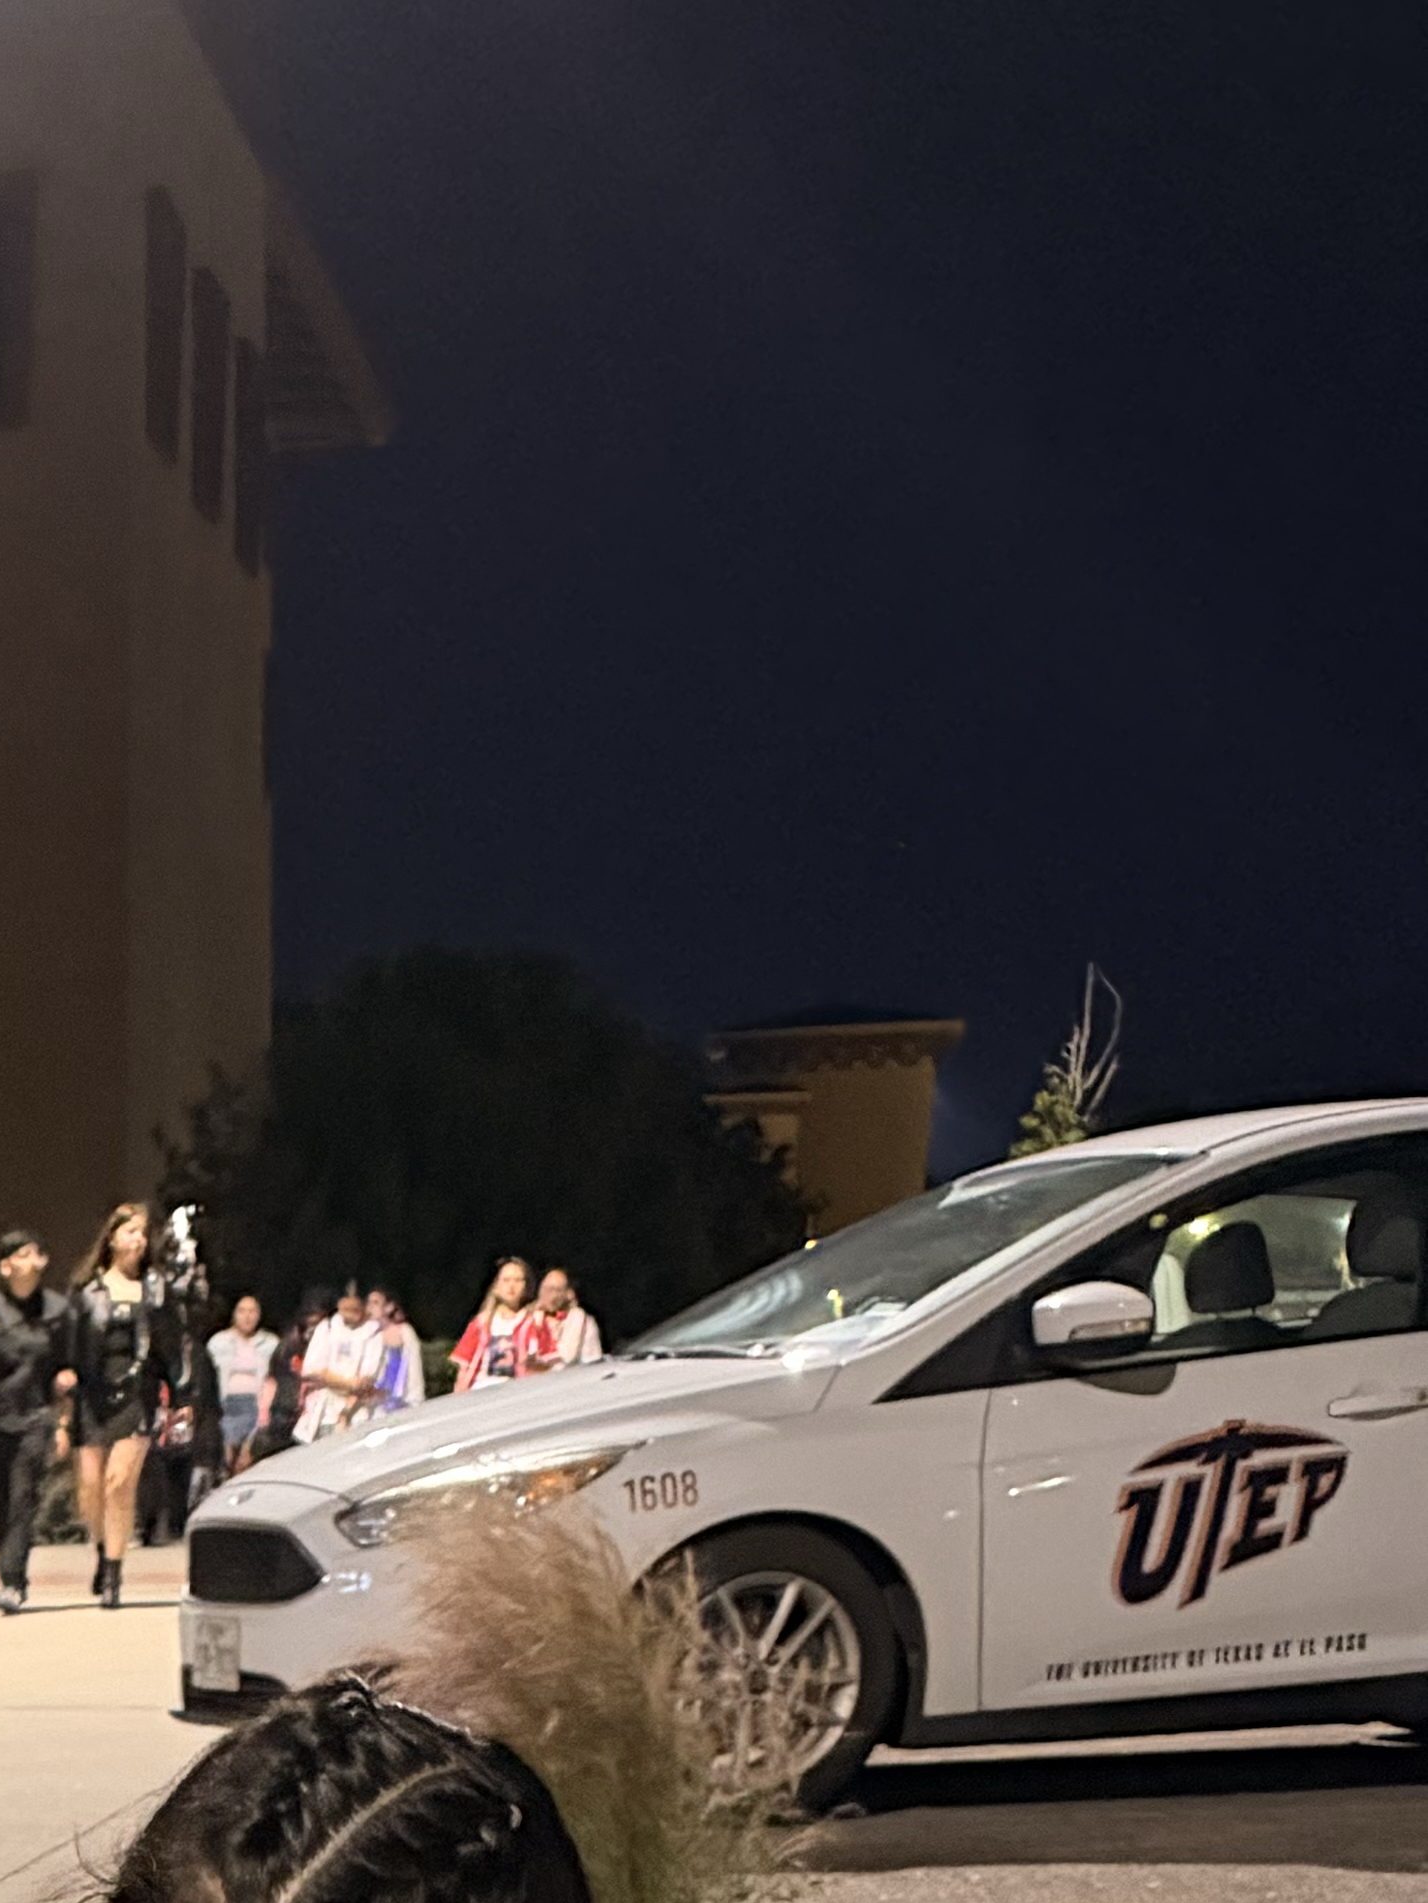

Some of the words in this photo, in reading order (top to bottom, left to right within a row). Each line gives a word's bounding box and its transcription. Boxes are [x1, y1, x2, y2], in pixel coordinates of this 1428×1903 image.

[623, 1469, 699, 1513] 1608
[1112, 1419, 1350, 1611] UTEP
[1080, 1651, 1180, 1679] UNIVERSITY
[1186, 1648, 1205, 1668] OF
[1214, 1642, 1265, 1665] TEXAS
[1273, 1639, 1291, 1659] AT
[1298, 1637, 1316, 1657] EL
[1324, 1633, 1368, 1654] PASO
